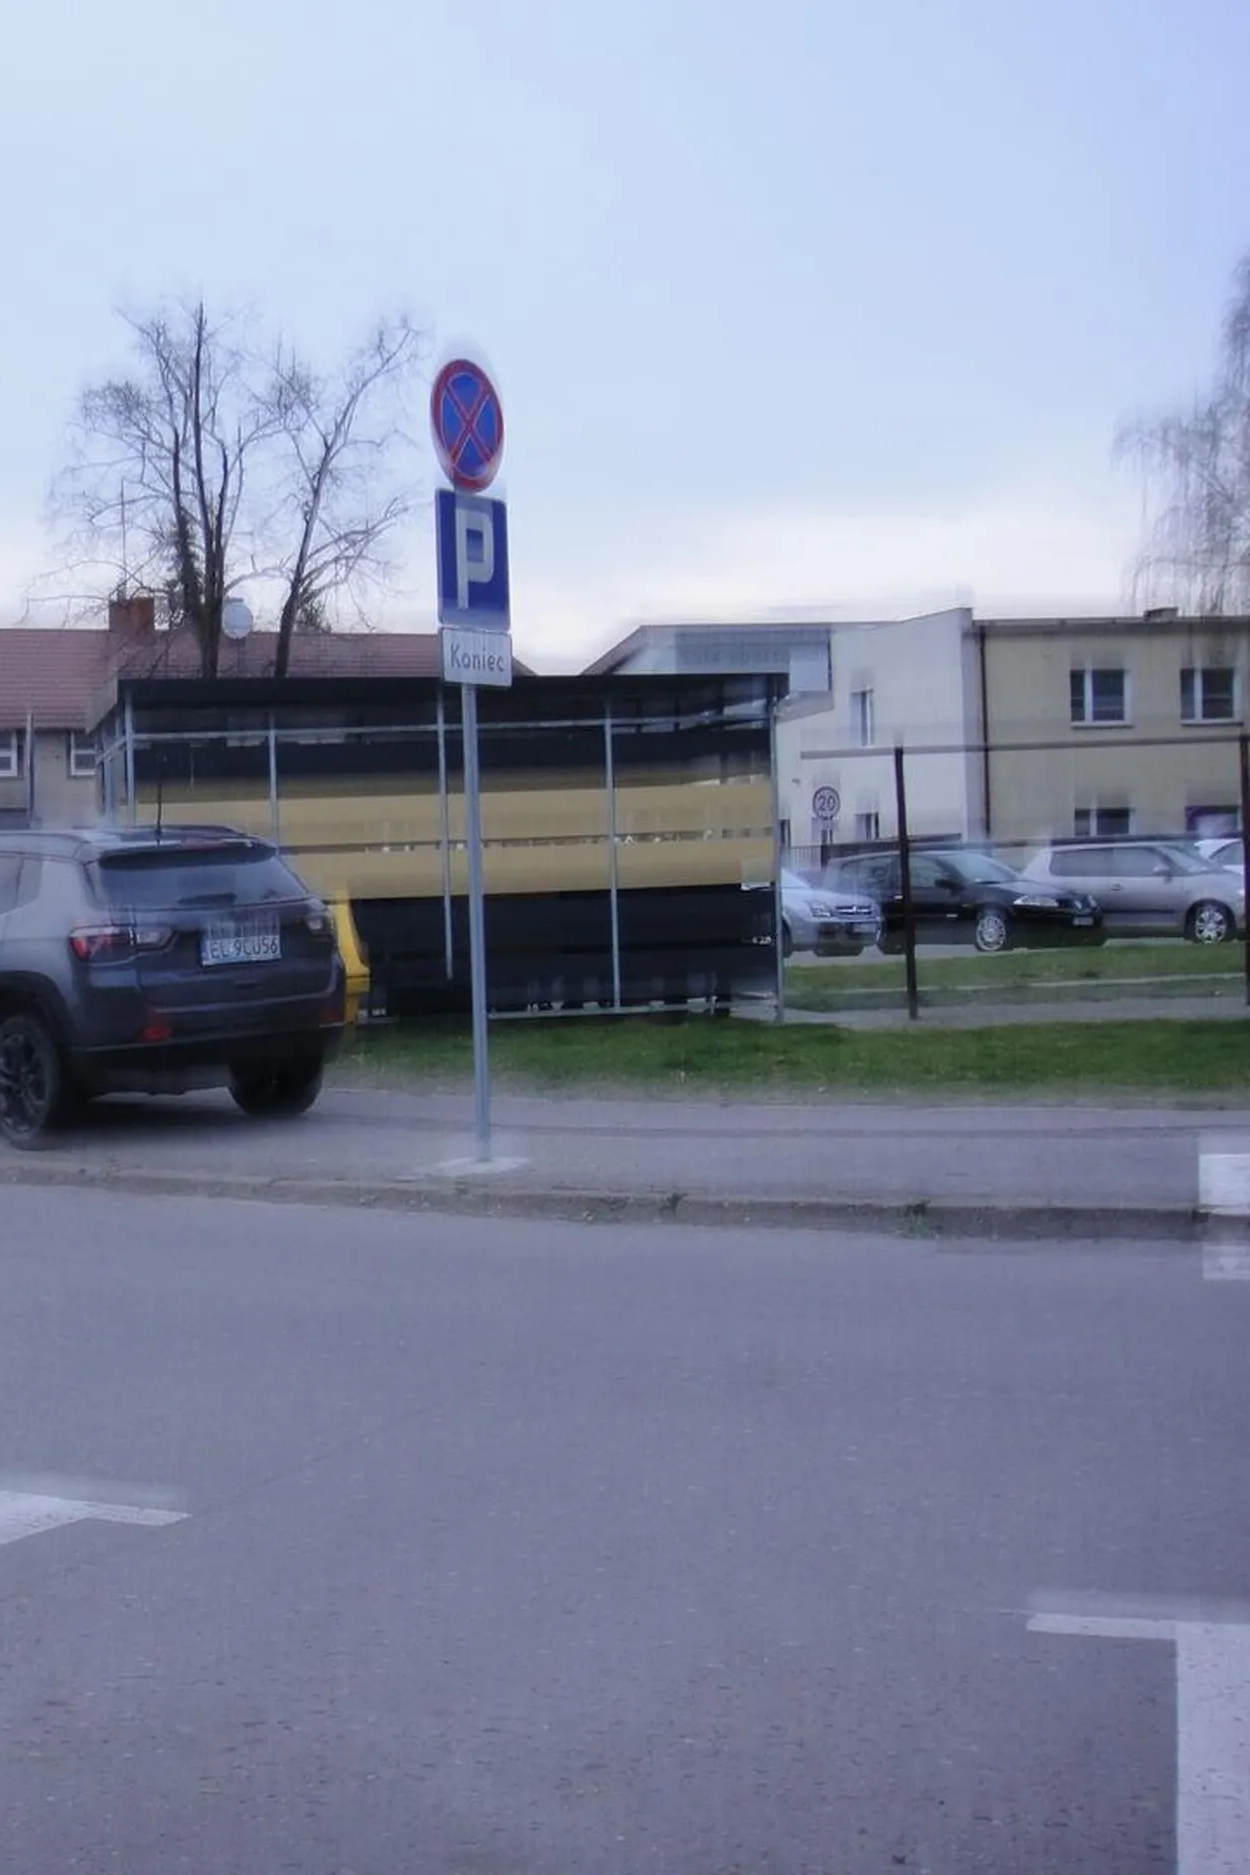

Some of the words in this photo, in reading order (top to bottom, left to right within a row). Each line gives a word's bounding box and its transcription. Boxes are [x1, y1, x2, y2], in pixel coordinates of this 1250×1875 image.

[455, 507, 494, 610] P
[450, 643, 505, 672] Koniec
[817, 795, 836, 812] 20
